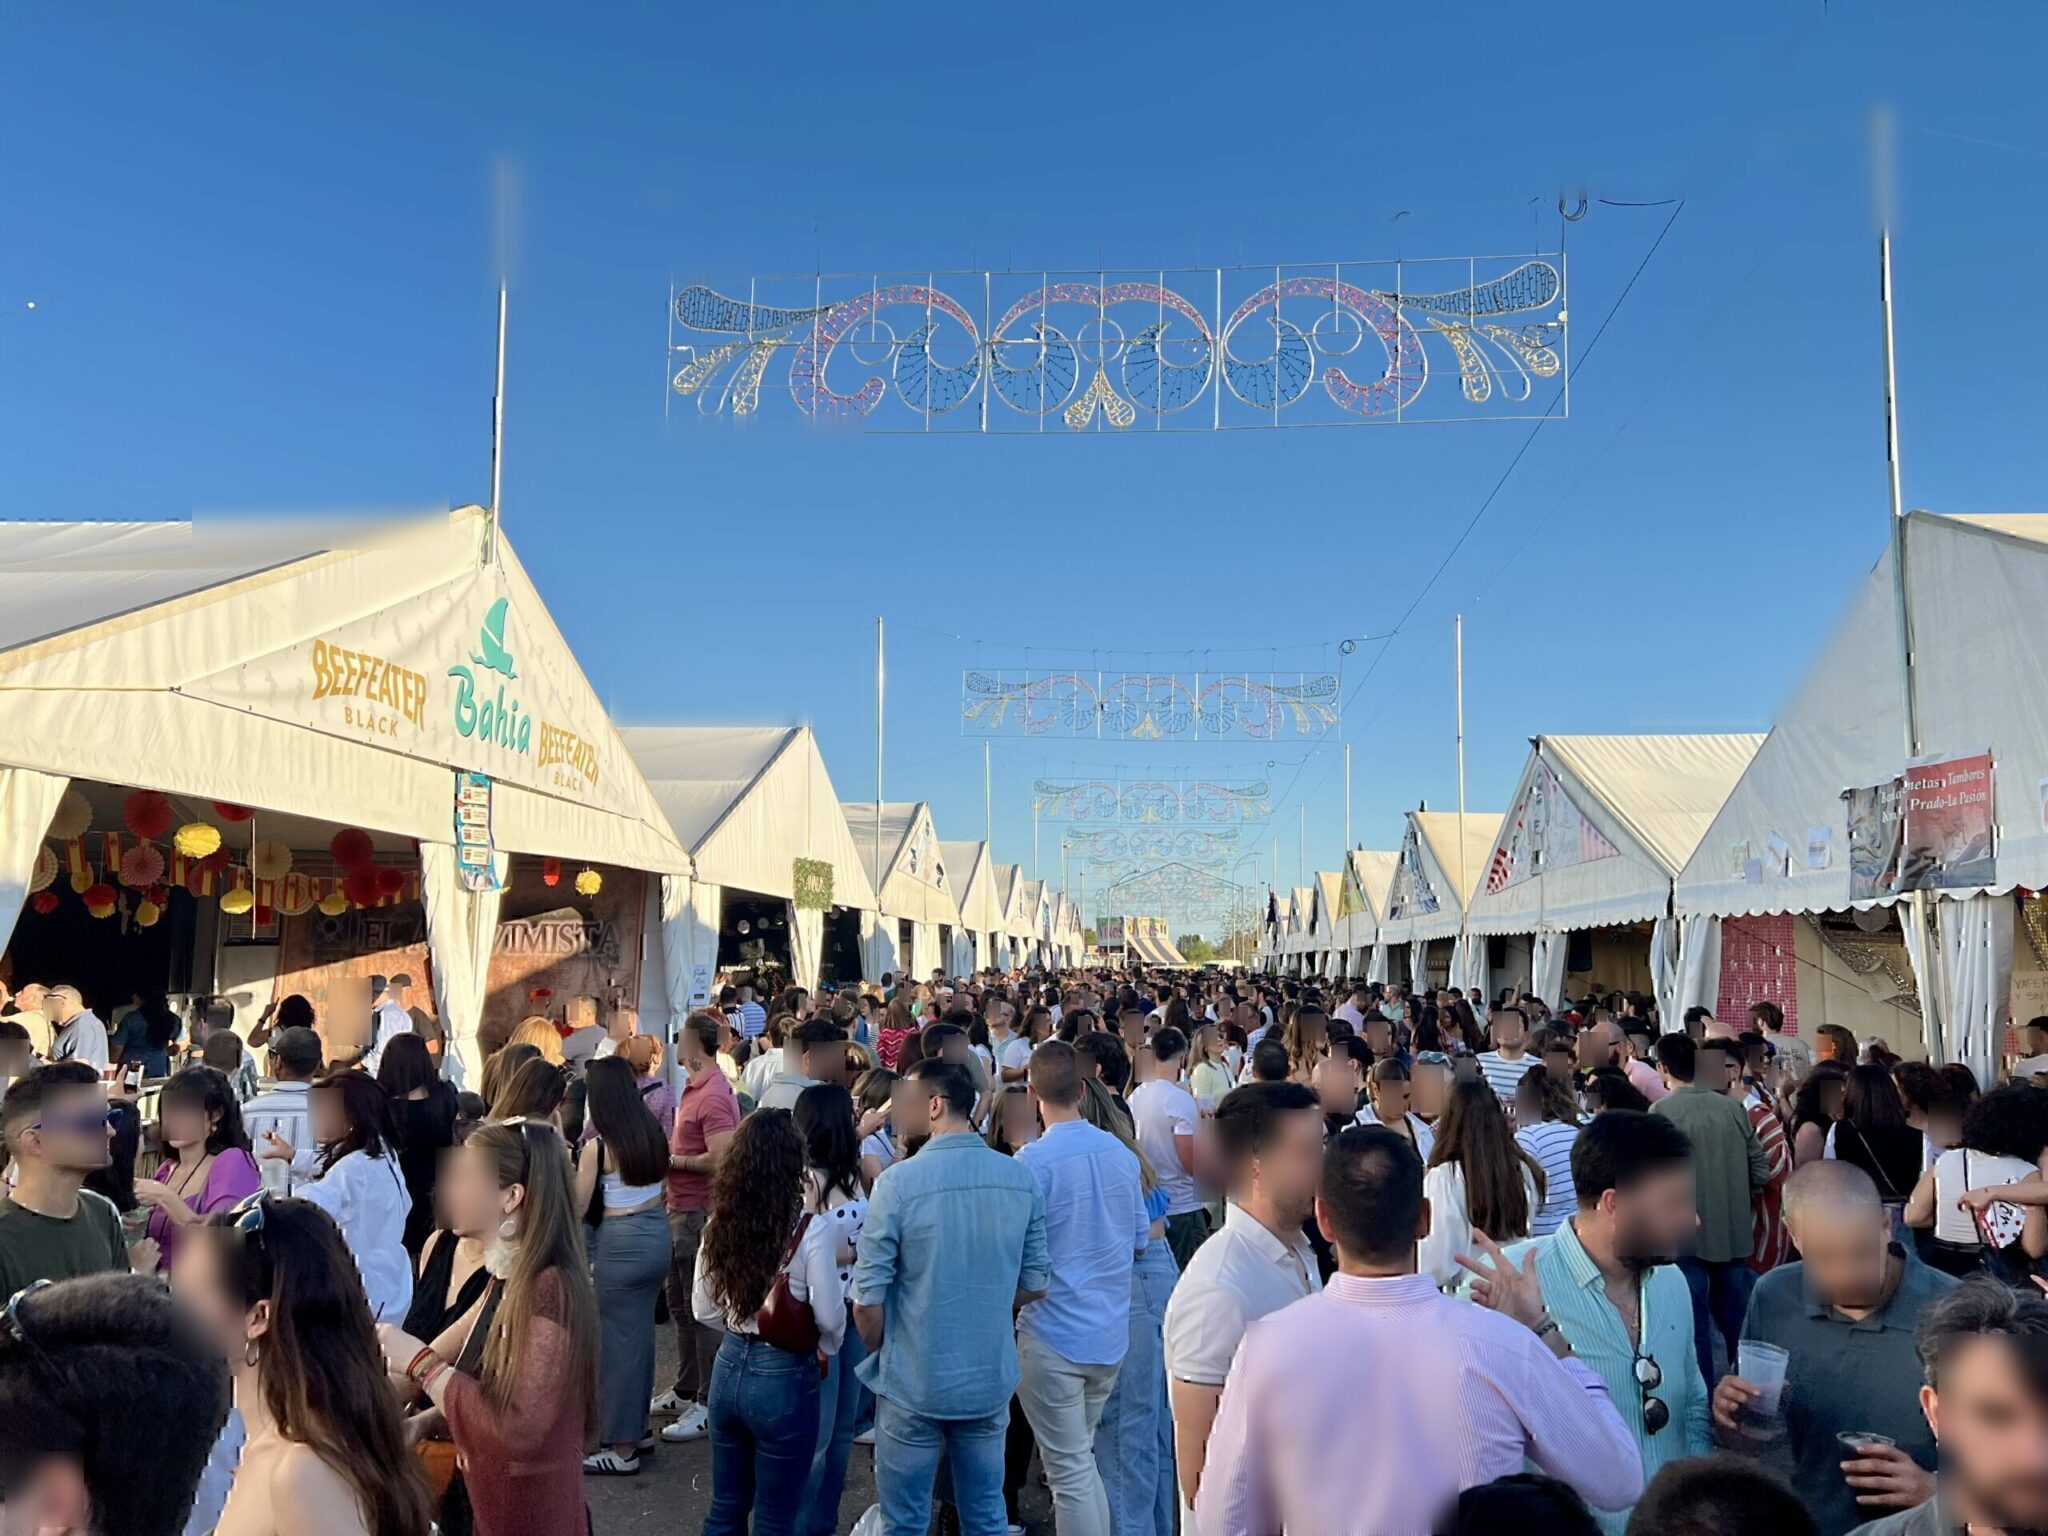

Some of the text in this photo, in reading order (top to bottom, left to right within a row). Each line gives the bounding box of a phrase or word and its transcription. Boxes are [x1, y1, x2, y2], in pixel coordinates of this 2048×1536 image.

[312, 639, 426, 731] BEEFEATER
[344, 706, 398, 737] BLACK
[537, 720, 599, 787] BEEFEATER
[553, 770, 584, 793] BLACK
[1948, 768, 1985, 786] Tambores
[1959, 787, 1987, 806] Pasión
